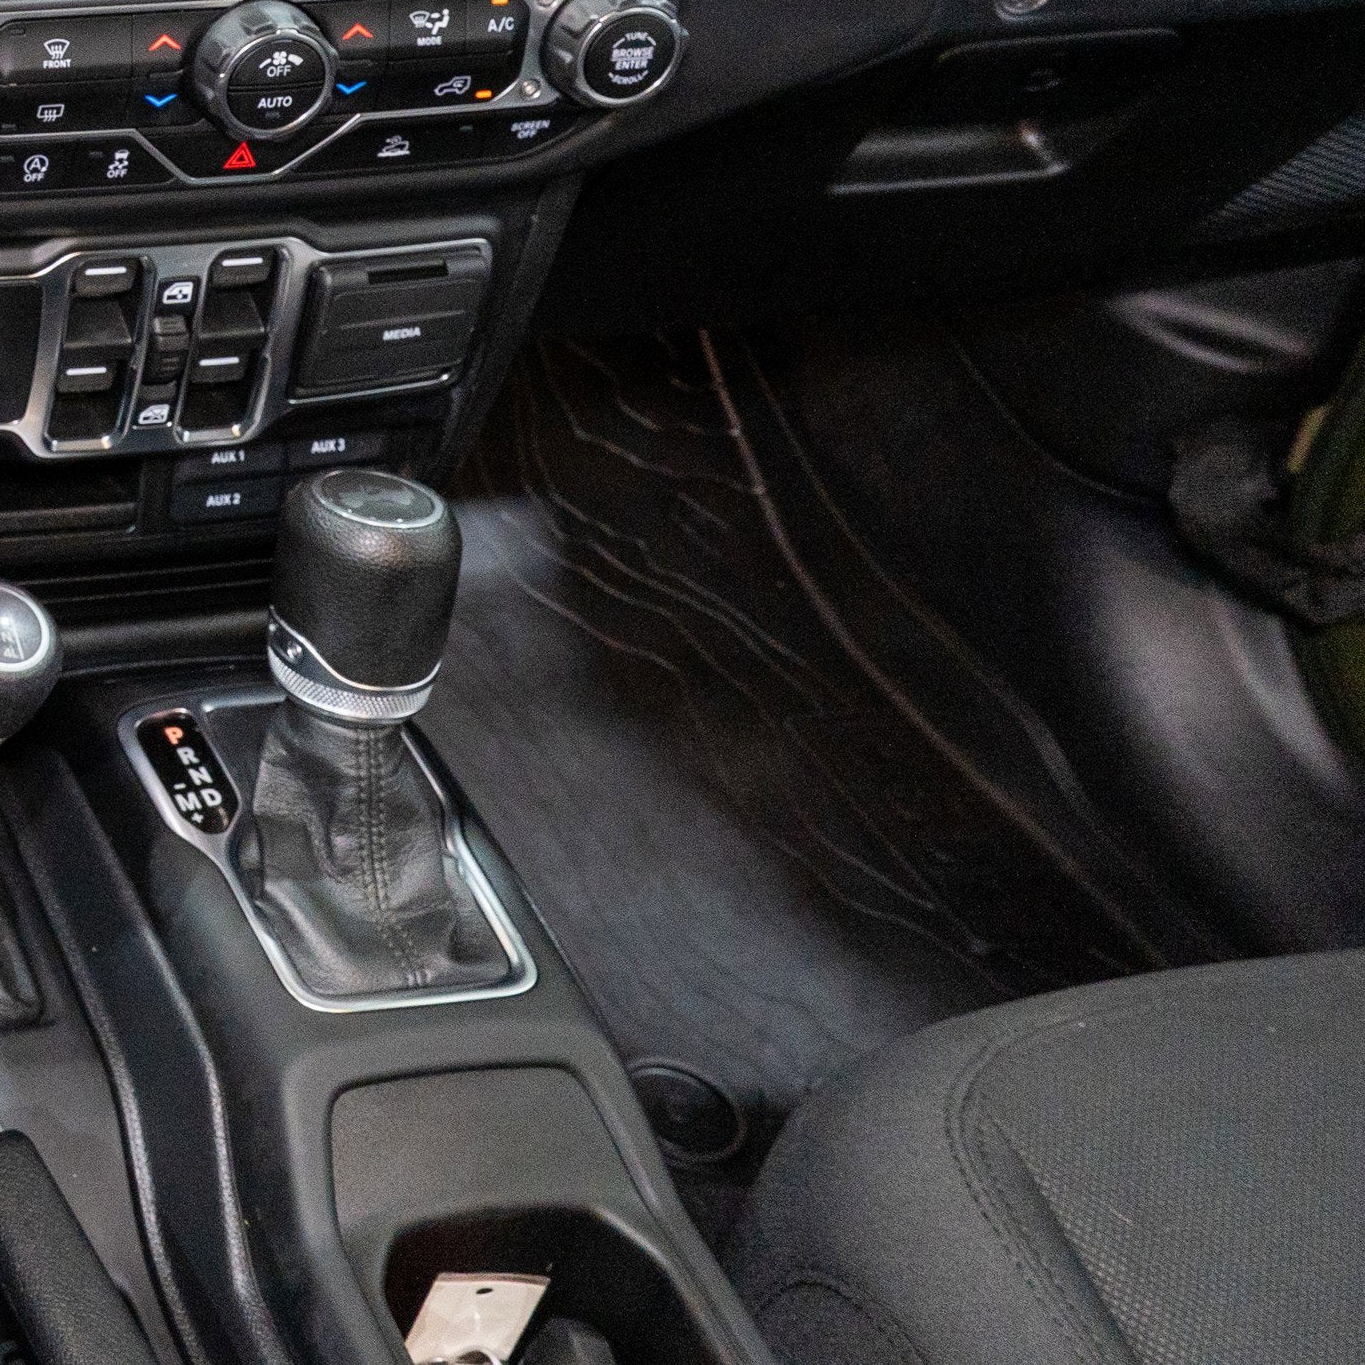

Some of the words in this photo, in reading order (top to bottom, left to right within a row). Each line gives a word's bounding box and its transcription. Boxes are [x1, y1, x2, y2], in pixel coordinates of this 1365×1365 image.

[488, 17, 515, 33] A/C
[417, 36, 441, 46] MODE
[43, 59, 72, 69] FRONT
[266, 64, 291, 78] OFF
[615, 60, 648, 70] ENTER
[257, 95, 293, 108] AUTO
[510, 120, 551, 133] SCREEN
[517, 129, 537, 138] OFF
[24, 171, 46, 182] OFF
[107, 168, 128, 178] OFF
[383, 326, 422, 341] MEDIA
[311, 440, 337, 455] AUX
[212, 451, 238, 465] AUX
[206, 493, 232, 506] AUX
[232, 492, 241, 505] 2
[165, 727, 184, 744] P
[177, 748, 199, 765] R
[189, 767, 212, 785] N
[175, 793, 202, 811] M
[201, 789, 222, 806] D
